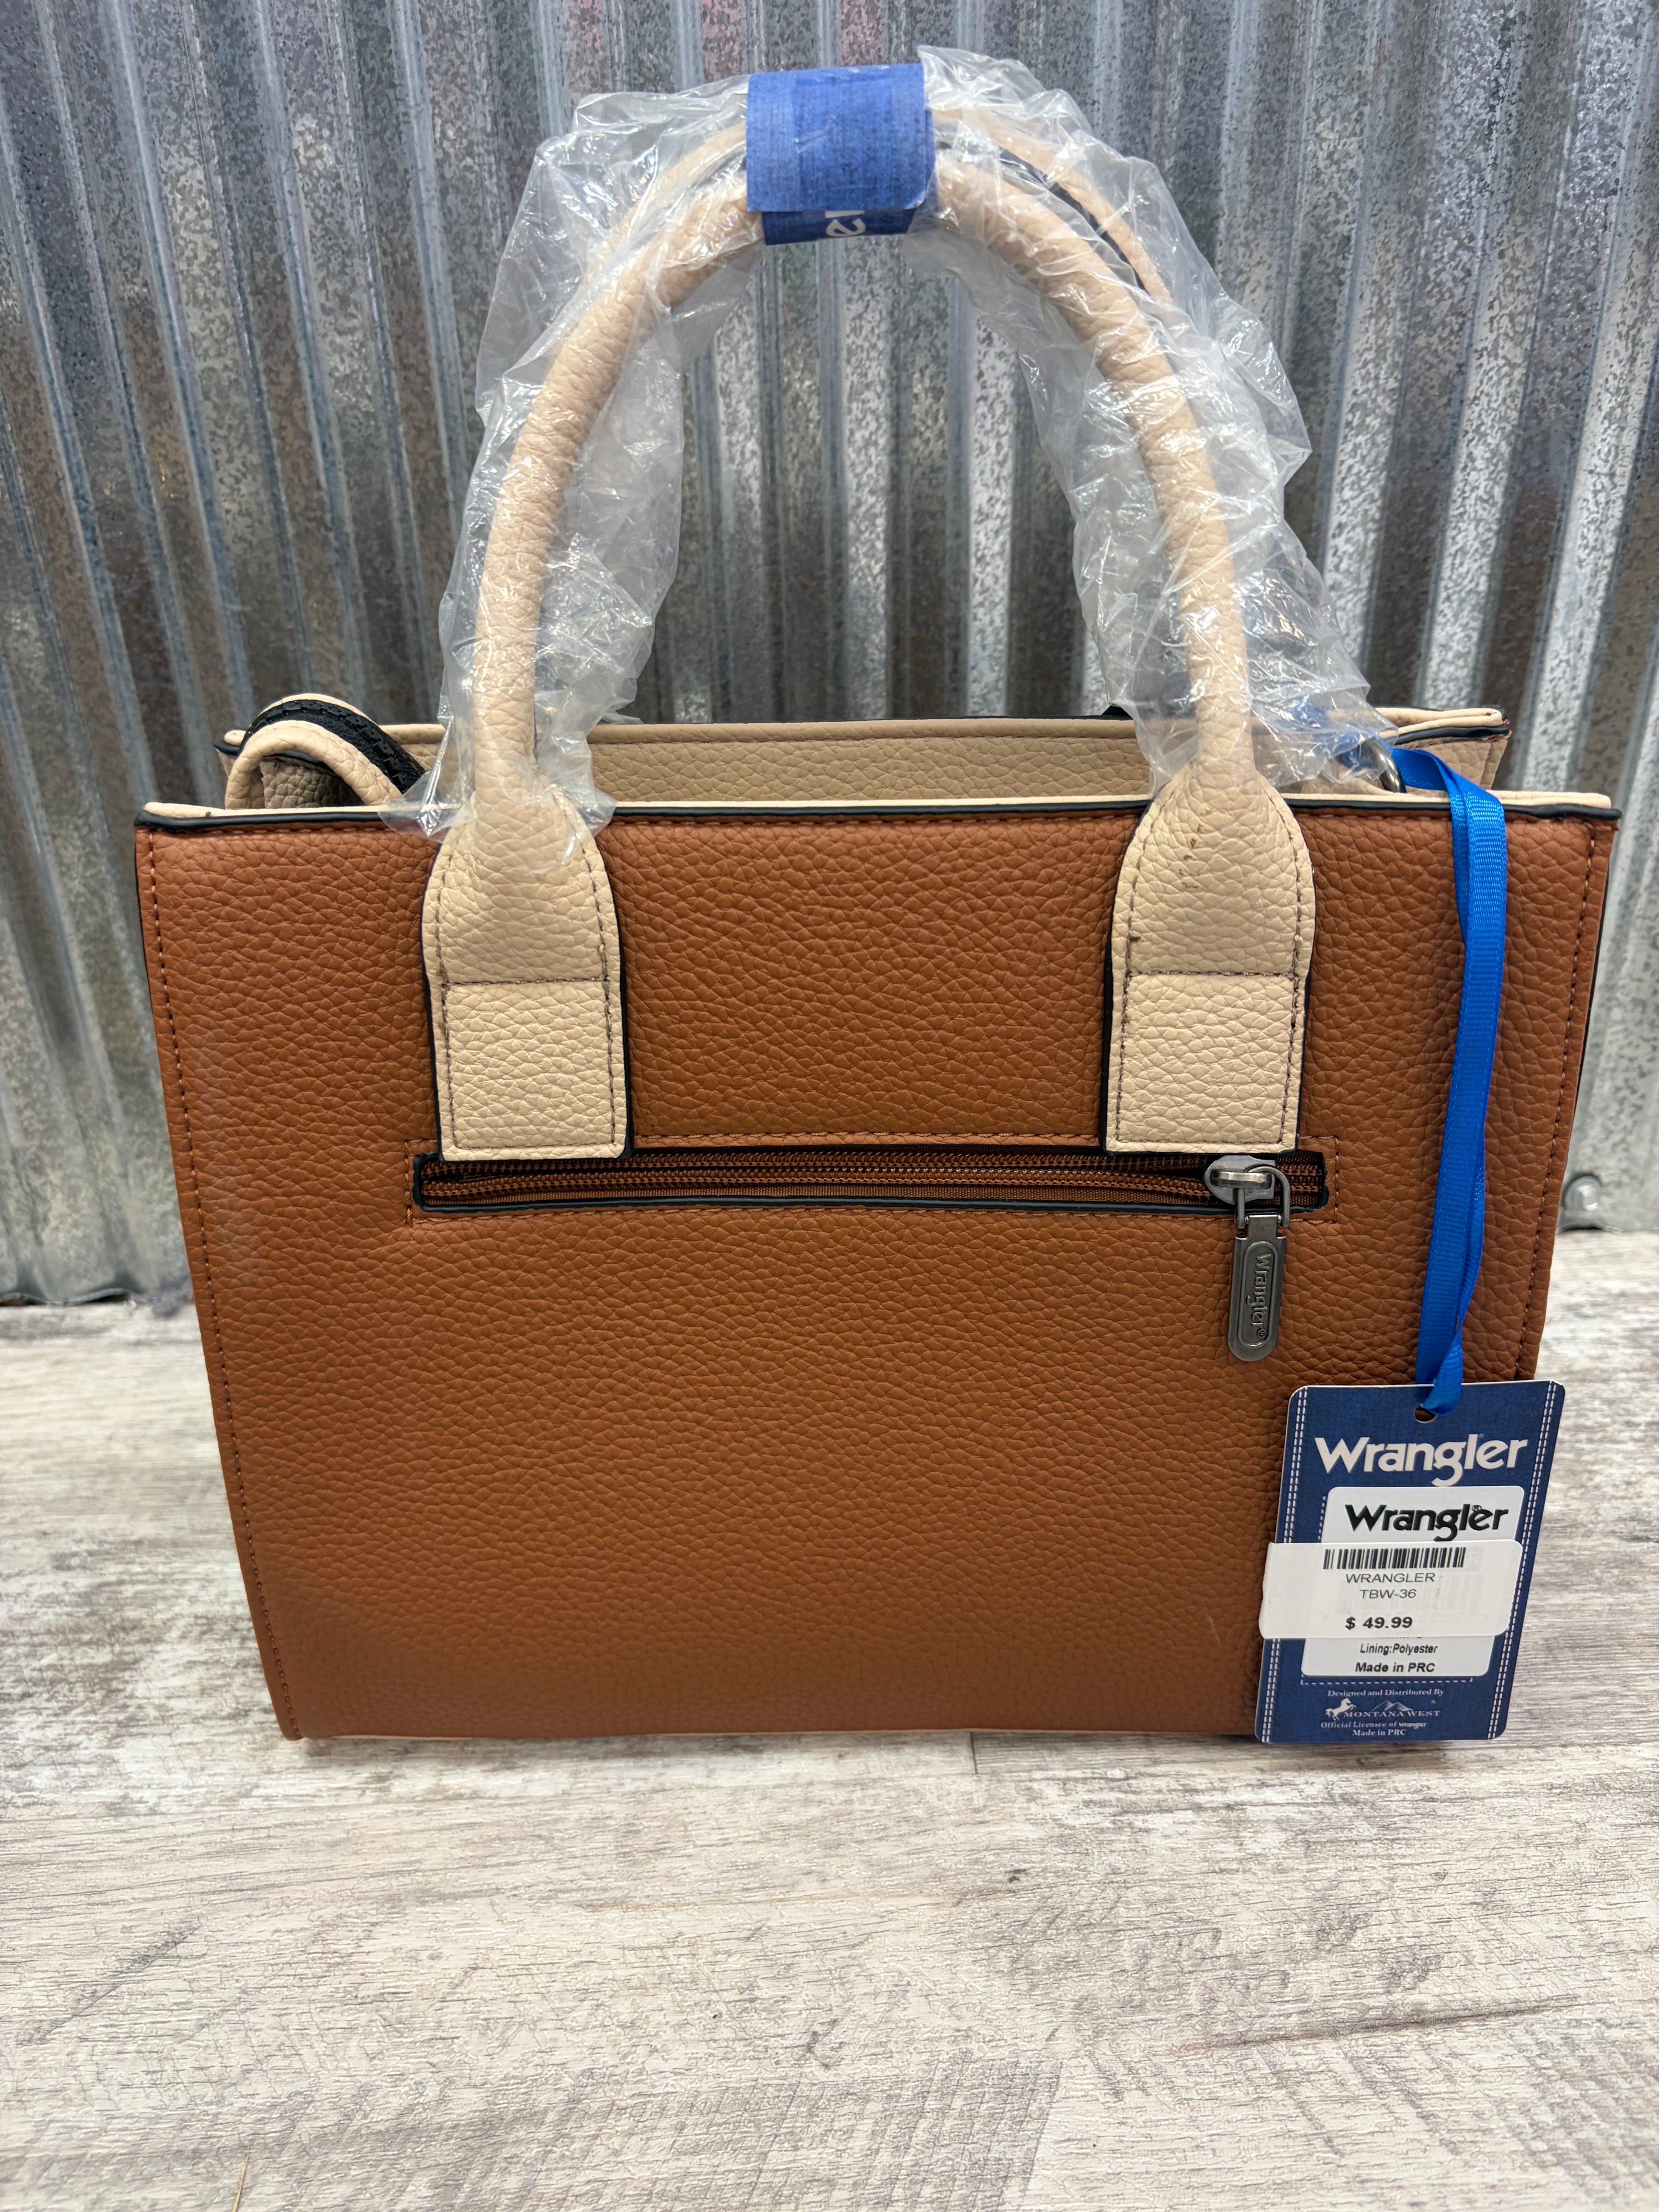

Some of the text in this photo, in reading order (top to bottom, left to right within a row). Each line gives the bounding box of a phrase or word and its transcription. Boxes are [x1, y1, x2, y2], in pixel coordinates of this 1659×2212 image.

[1246, 1254, 1272, 1327] Wrangler
[1314, 1433, 1528, 1487] Wrangler
[1345, 1503, 1509, 1542] Wrangler
[1345, 1572, 1436, 1583] WRANGLER
[1359, 1589, 1417, 1599] TBW-36
[1344, 1616, 1413, 1630] $ 49.99
[1360, 1643, 1438, 1656] Lining:Polyester
[1355, 1662, 1436, 1672] Made in PRC
